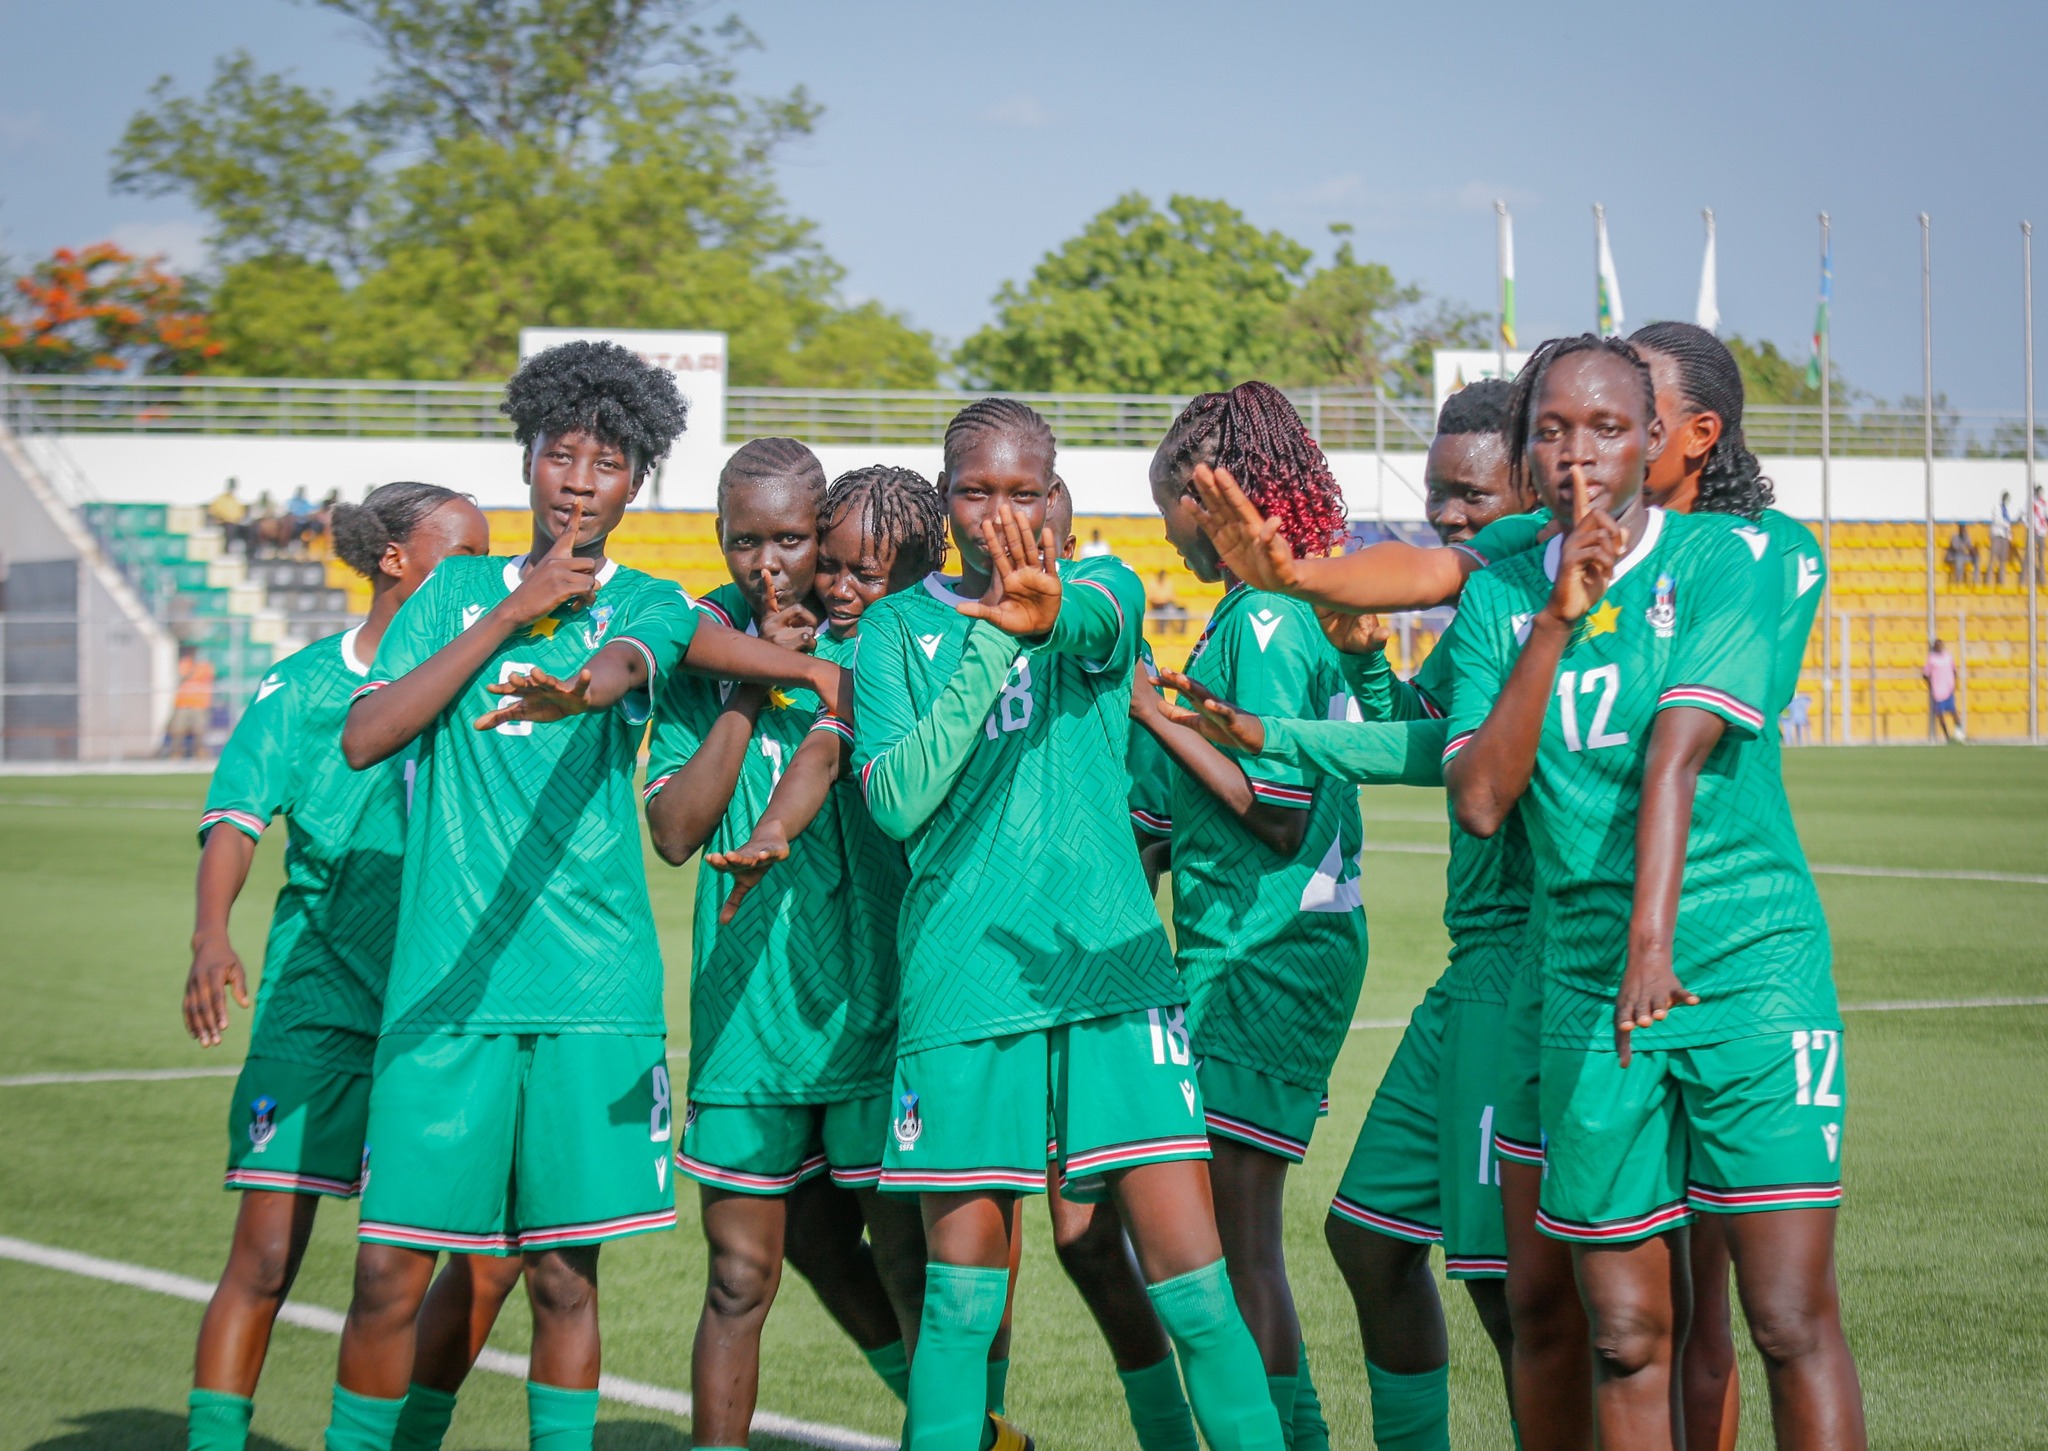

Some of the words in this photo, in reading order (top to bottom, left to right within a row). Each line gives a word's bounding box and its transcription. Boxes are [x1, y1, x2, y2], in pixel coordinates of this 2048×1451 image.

[1556, 662, 1629, 752] 12
[1146, 1004, 1190, 1067] 18
[1792, 1029, 1840, 1107] 12
[650, 1065, 671, 1142] 8
[1478, 1105, 1501, 1187] 1
